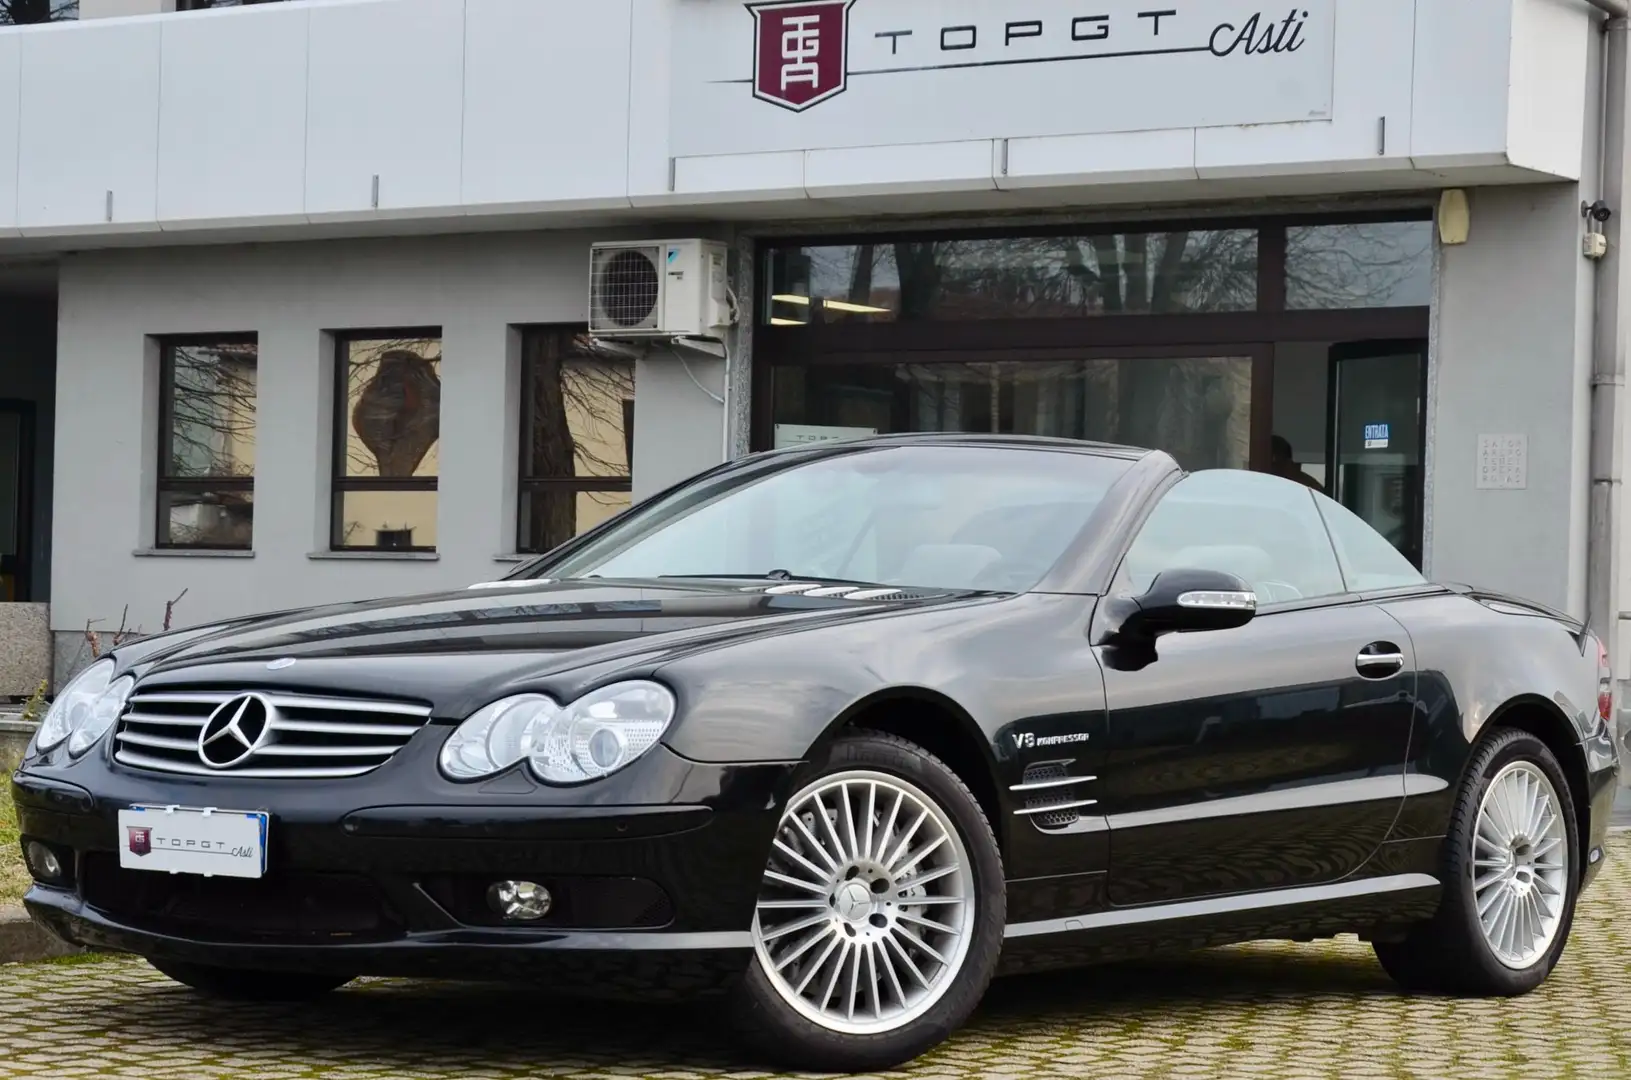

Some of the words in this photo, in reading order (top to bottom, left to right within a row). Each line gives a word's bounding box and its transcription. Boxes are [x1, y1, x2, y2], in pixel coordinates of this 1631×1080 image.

[875, 10, 1177, 55] TOPGT
[1209, 10, 1308, 57] Asti
[1365, 424, 1388, 439] ENTRATA
[1012, 732, 1035, 749] V8
[156, 837, 226, 849] TOPGT
[232, 845, 253, 858] Asti
